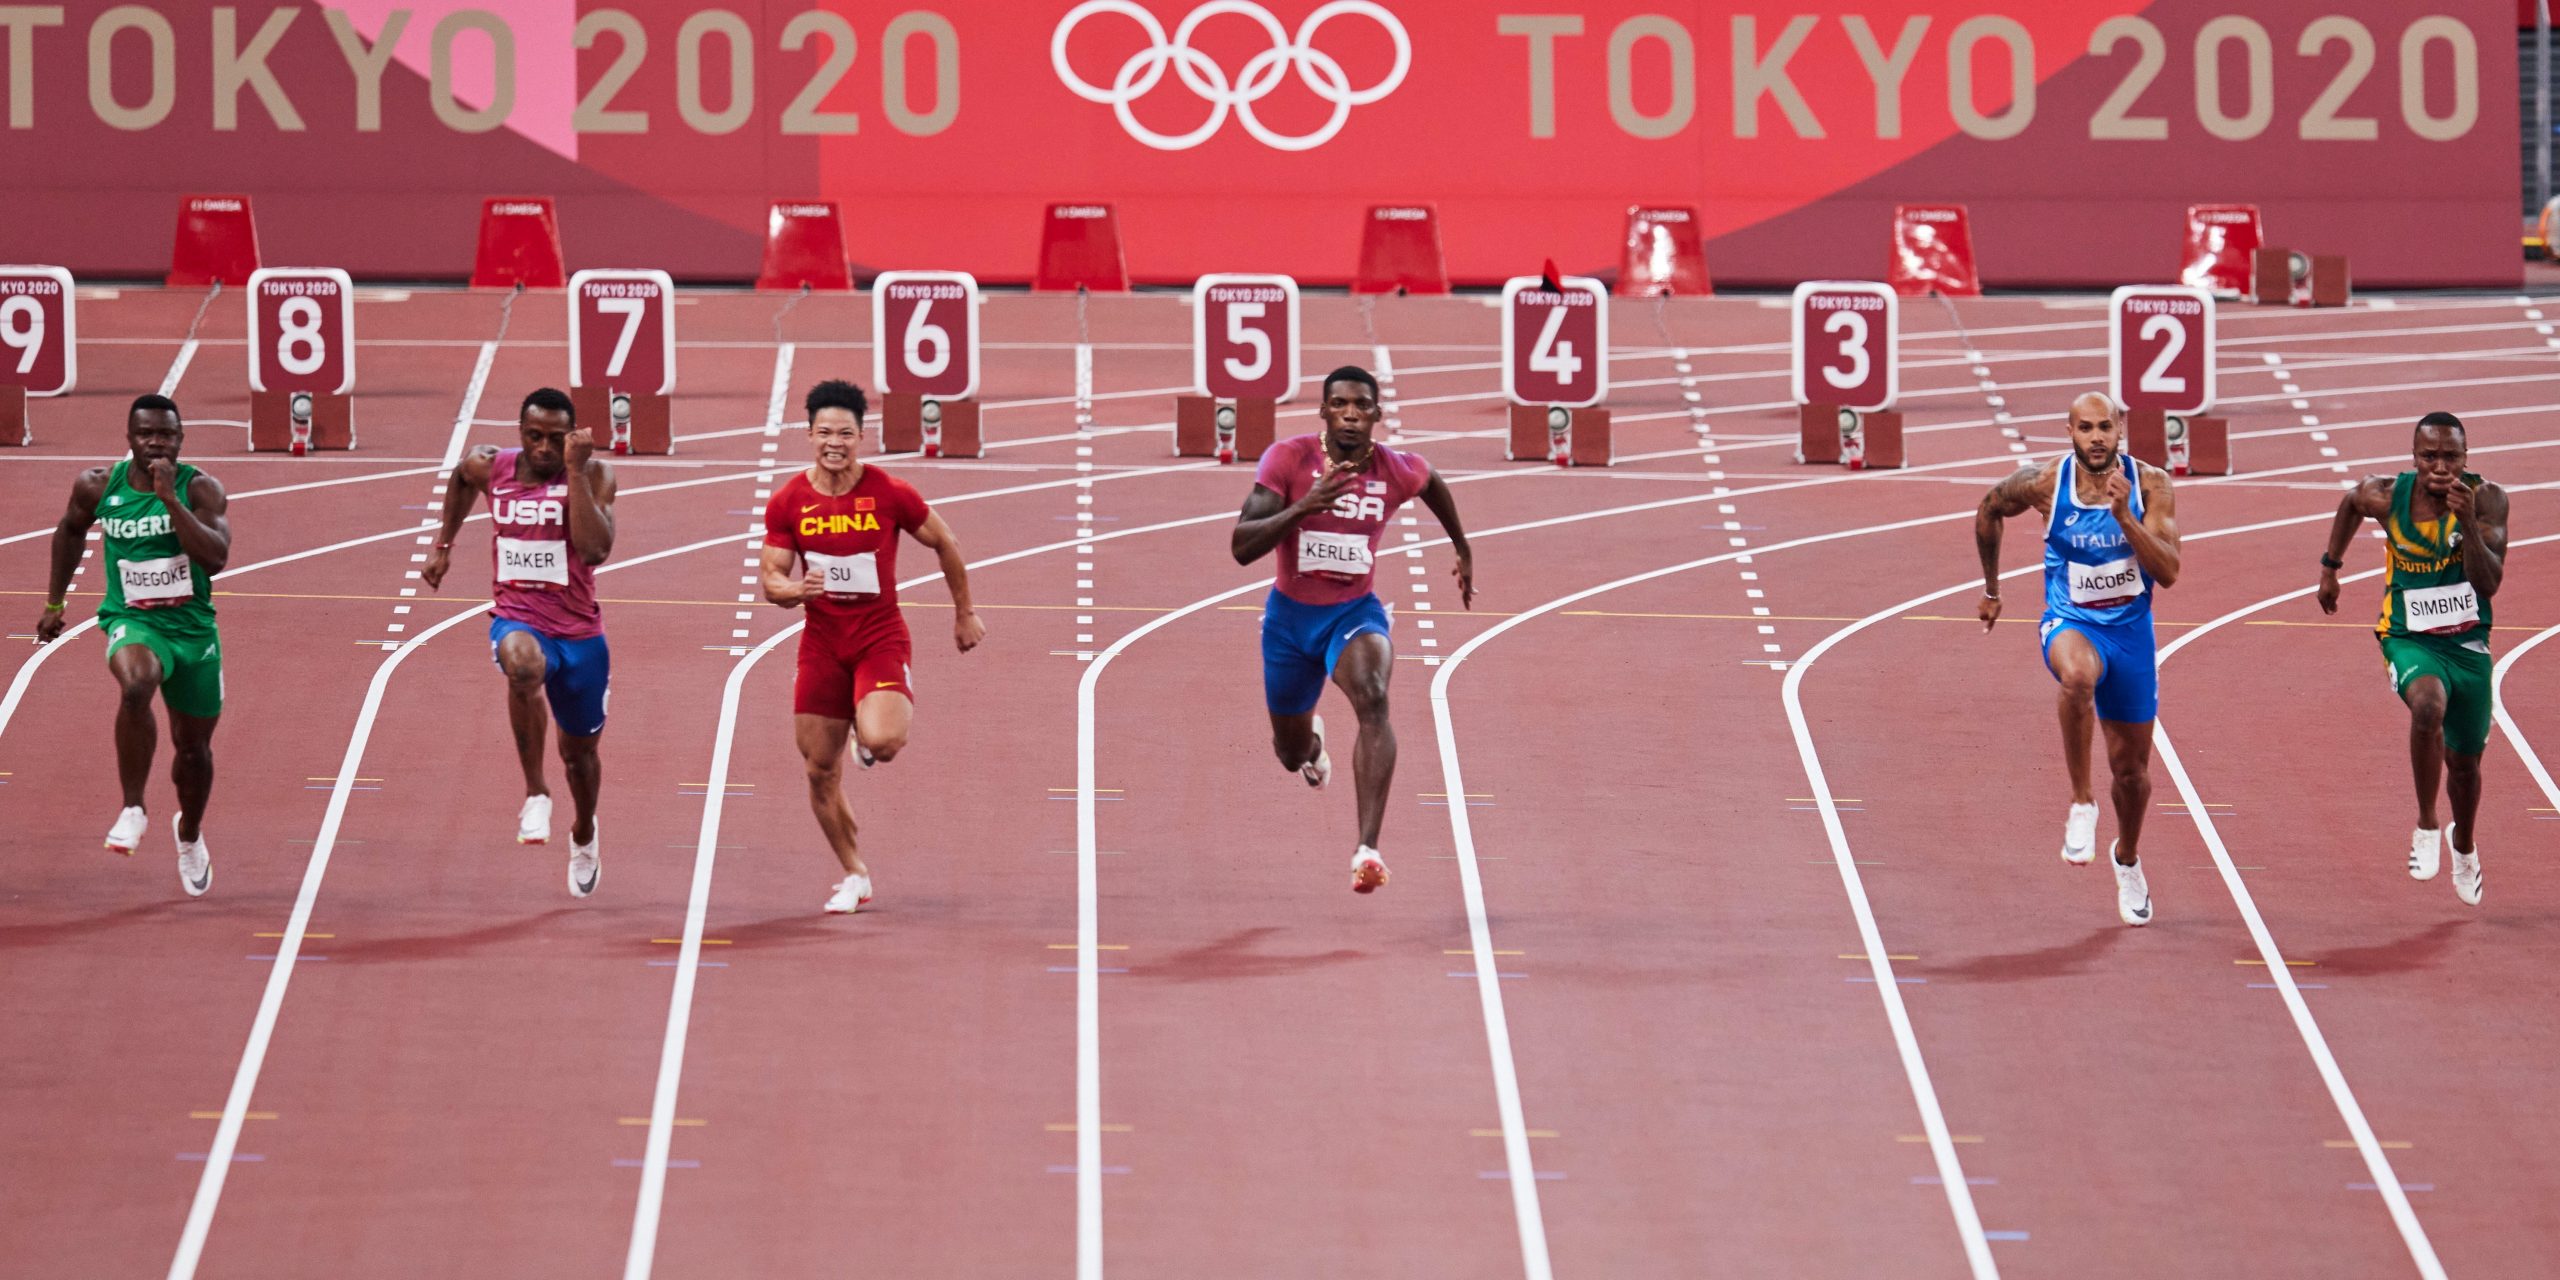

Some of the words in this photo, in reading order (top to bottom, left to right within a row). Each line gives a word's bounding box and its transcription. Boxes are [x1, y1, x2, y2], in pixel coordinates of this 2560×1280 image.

[0, 6, 517, 133] TOKYO
[571, 9, 960, 136] 2020
[1497, 14, 2036, 140] TOKYO
[2088, 15, 2480, 141] 2020
[28, 281, 58, 294] 2020
[263, 282, 303, 296] TOKYO
[306, 282, 337, 295] 2020
[584, 284, 625, 297] TOKYO
[627, 284, 659, 297] 2020
[890, 285, 930, 299] TOKYO
[932, 285, 964, 299] 2020
[1210, 288, 1251, 302] TOKYO
[1253, 288, 1284, 302] 2020
[1519, 292, 1560, 306] TOKYO
[1562, 292, 1594, 306] 2020
[1810, 295, 1851, 310] TOKYO
[1853, 296, 1884, 311] 2020
[2126, 300, 2167, 314] TOKYO
[2169, 301, 2201, 315] 2020
[0, 295, 45, 373] 9
[278, 296, 325, 375] 8
[597, 297, 645, 377] 7
[904, 299, 950, 378] 6
[1224, 302, 1272, 381] 5
[1529, 306, 1582, 385] 4
[1822, 310, 1870, 389] 3
[2139, 314, 2186, 393] 2
[493, 498, 563, 525] USA
[1322, 493, 1385, 521] SA
[101, 514, 176, 539] NIGERI
[800, 512, 880, 536] CHINA
[506, 550, 555, 568] BAKER
[125, 564, 188, 586] ADEGOKE
[830, 567, 851, 581] SU
[2077, 568, 2136, 590] JACOBS
[2411, 593, 2473, 617] SIMBINE
